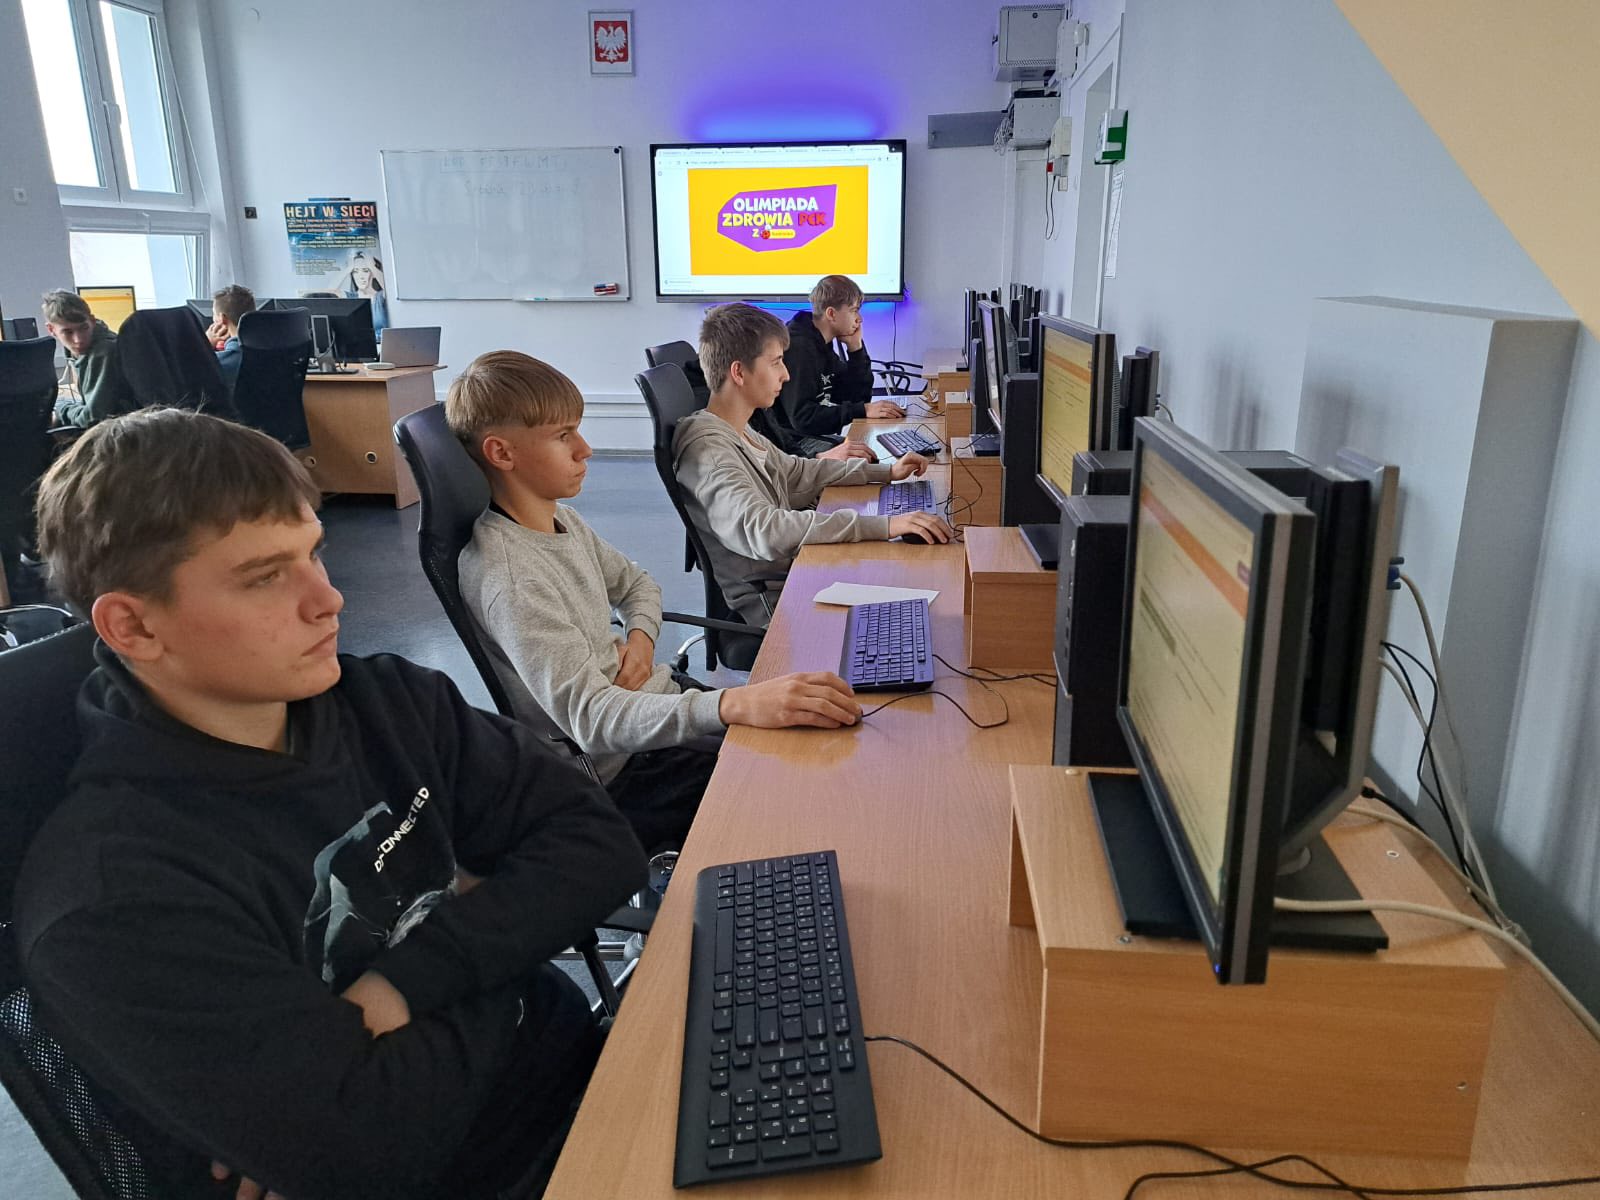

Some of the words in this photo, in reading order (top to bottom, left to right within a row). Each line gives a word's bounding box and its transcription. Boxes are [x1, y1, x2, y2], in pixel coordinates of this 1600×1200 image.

[286, 206, 317, 218] HEJT
[322, 206, 335, 217] W
[340, 205, 375, 217] SIECI
[733, 197, 819, 212] OLIMPIADA
[722, 212, 794, 227] ZDROWIA
[797, 212, 827, 226] PCK
